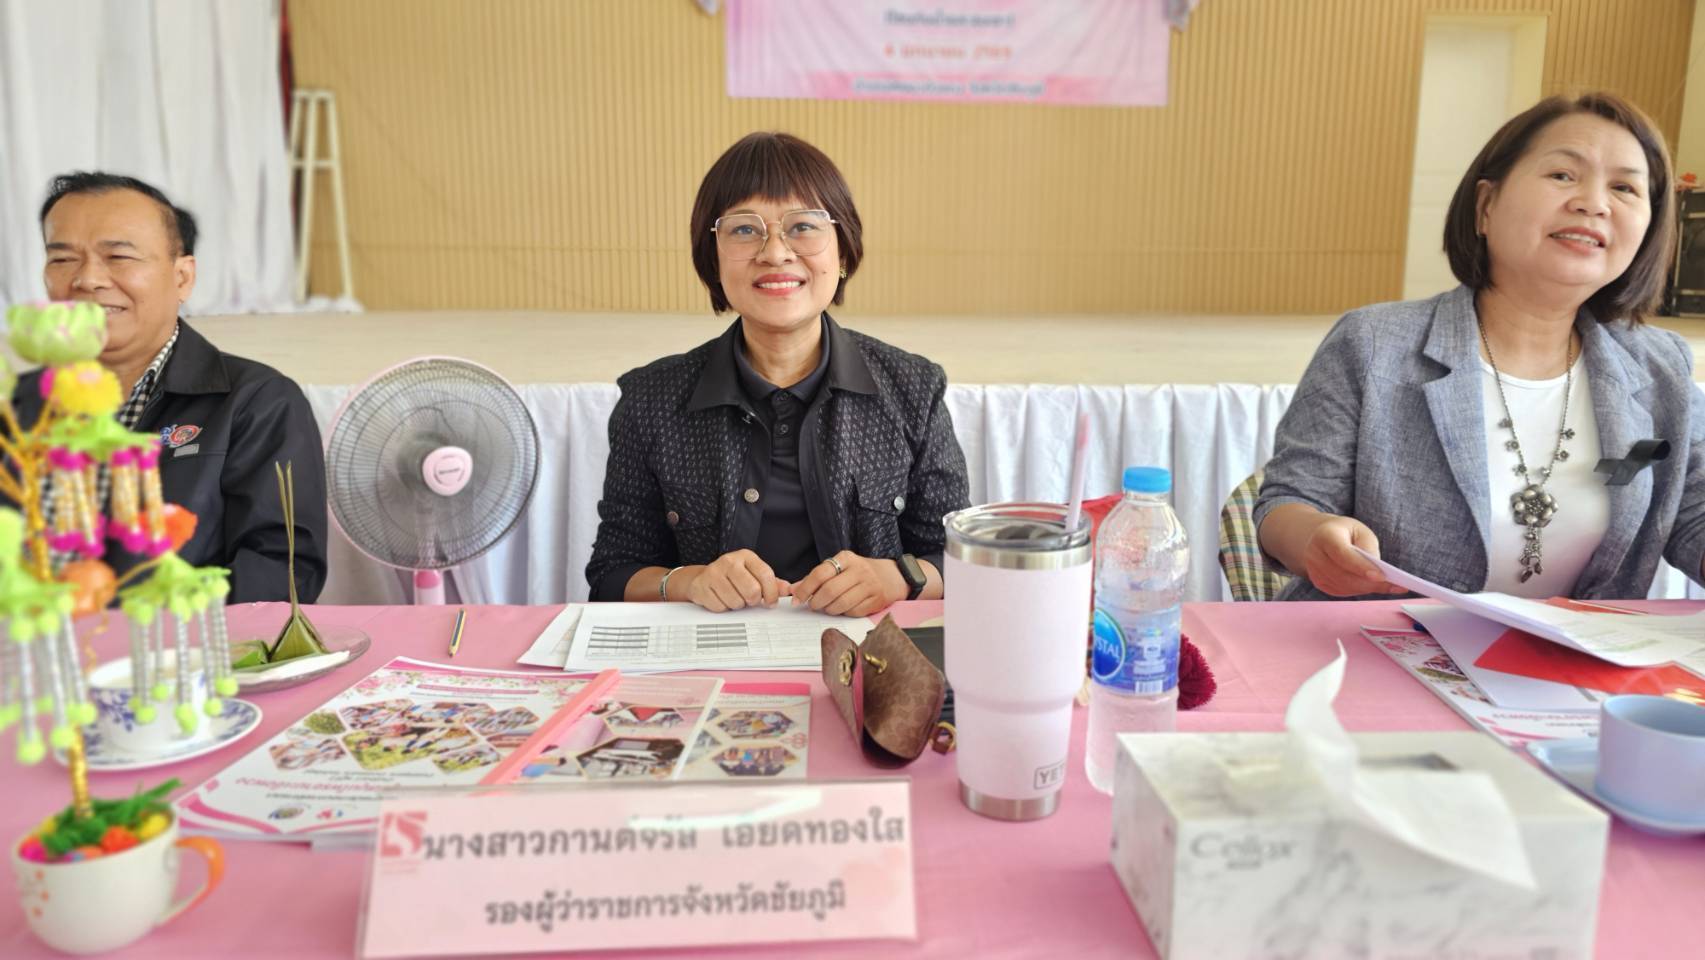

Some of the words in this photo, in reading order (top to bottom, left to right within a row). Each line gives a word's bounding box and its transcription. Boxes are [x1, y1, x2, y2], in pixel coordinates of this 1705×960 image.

[721, 806, 906, 850] เอยดทองใส
[485, 879, 847, 934] รองผู้ว่าราชการจังหวัดชัยภูมิ
